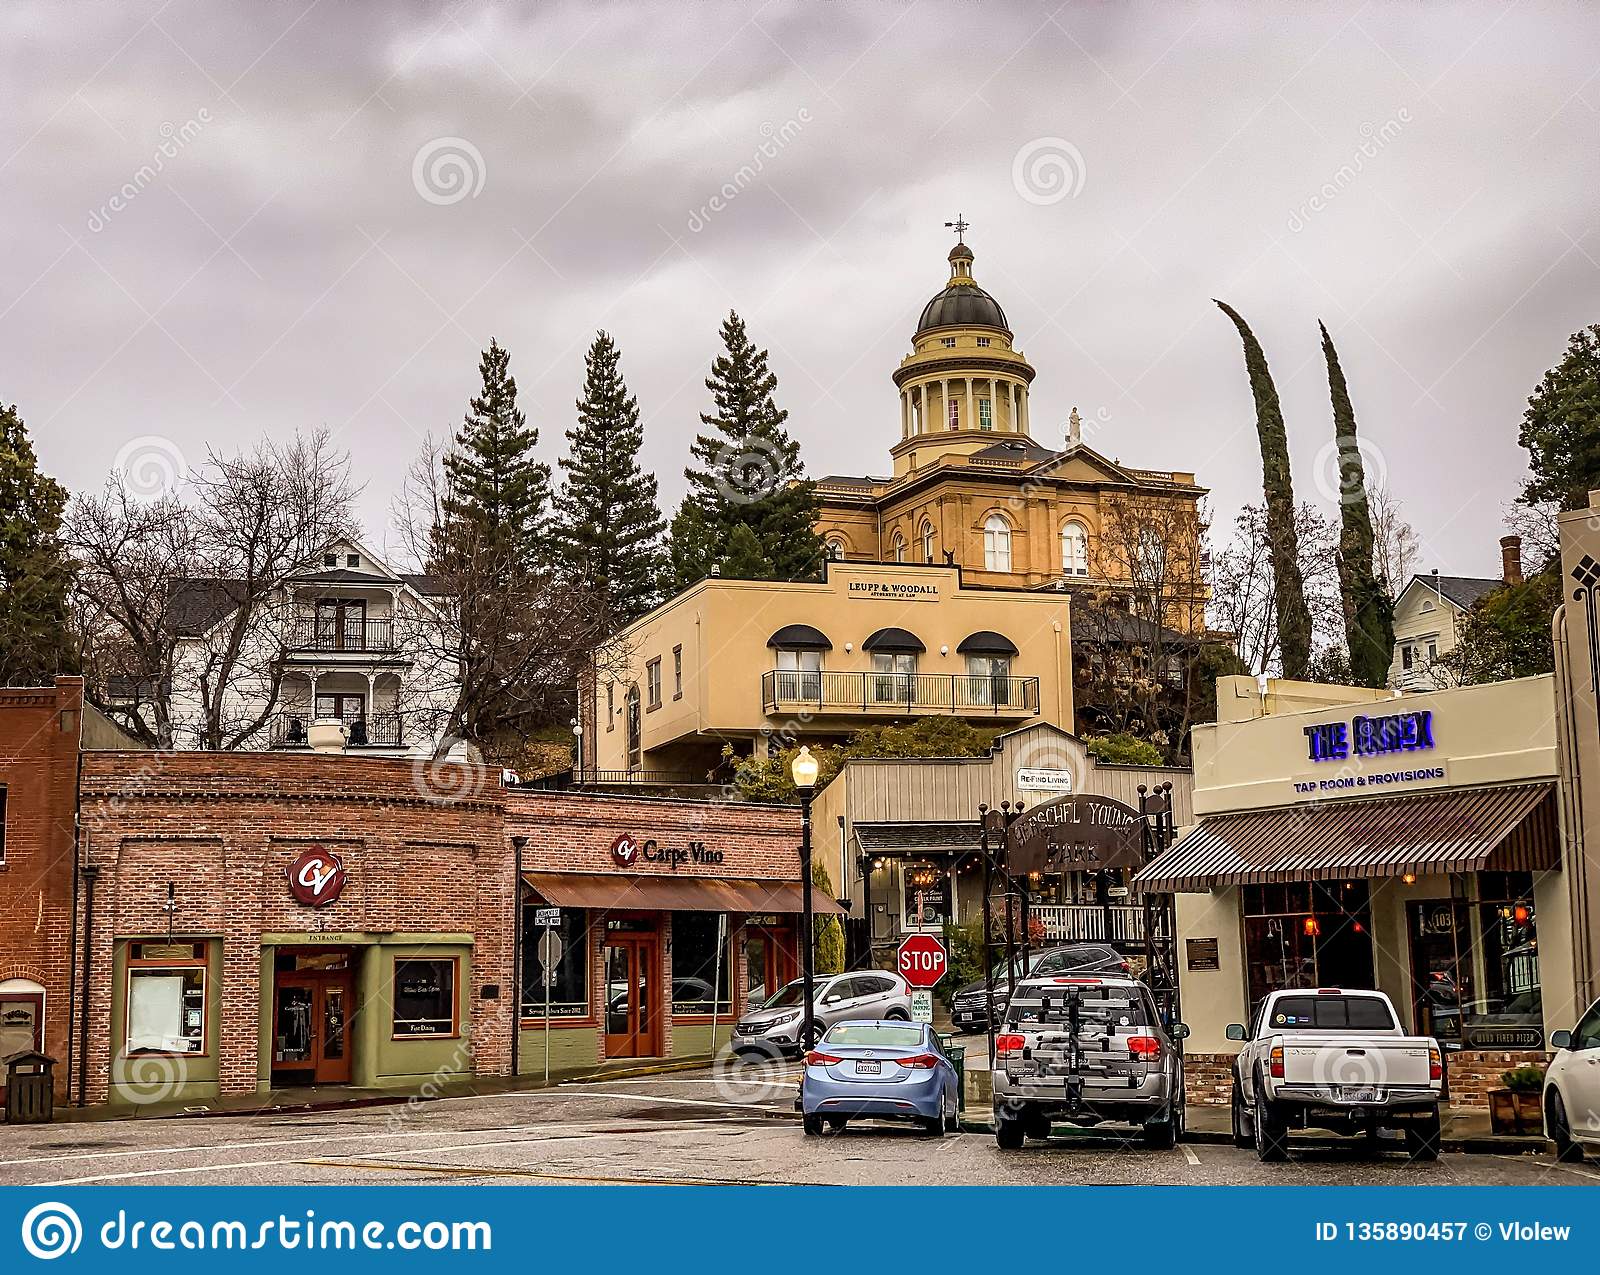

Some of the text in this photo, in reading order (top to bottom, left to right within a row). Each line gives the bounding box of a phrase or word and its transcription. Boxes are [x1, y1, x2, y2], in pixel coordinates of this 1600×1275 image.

[849, 582, 938, 594] LEUPP & WOODALL
[1303, 722, 1349, 762] THE
[1047, 776, 1069, 785] LIVING
[1294, 767, 1445, 793] TAP ROOM & PROVISIONS
[642, 840, 724, 871] Carpe Vino
[1047, 840, 1101, 862] PARK
[1434, 913, 1451, 927] 103
[900, 950, 944, 971] STOP
[1496, 1033, 1514, 1042] FIRED
[1516, 1033, 1535, 1043] PIZZA
